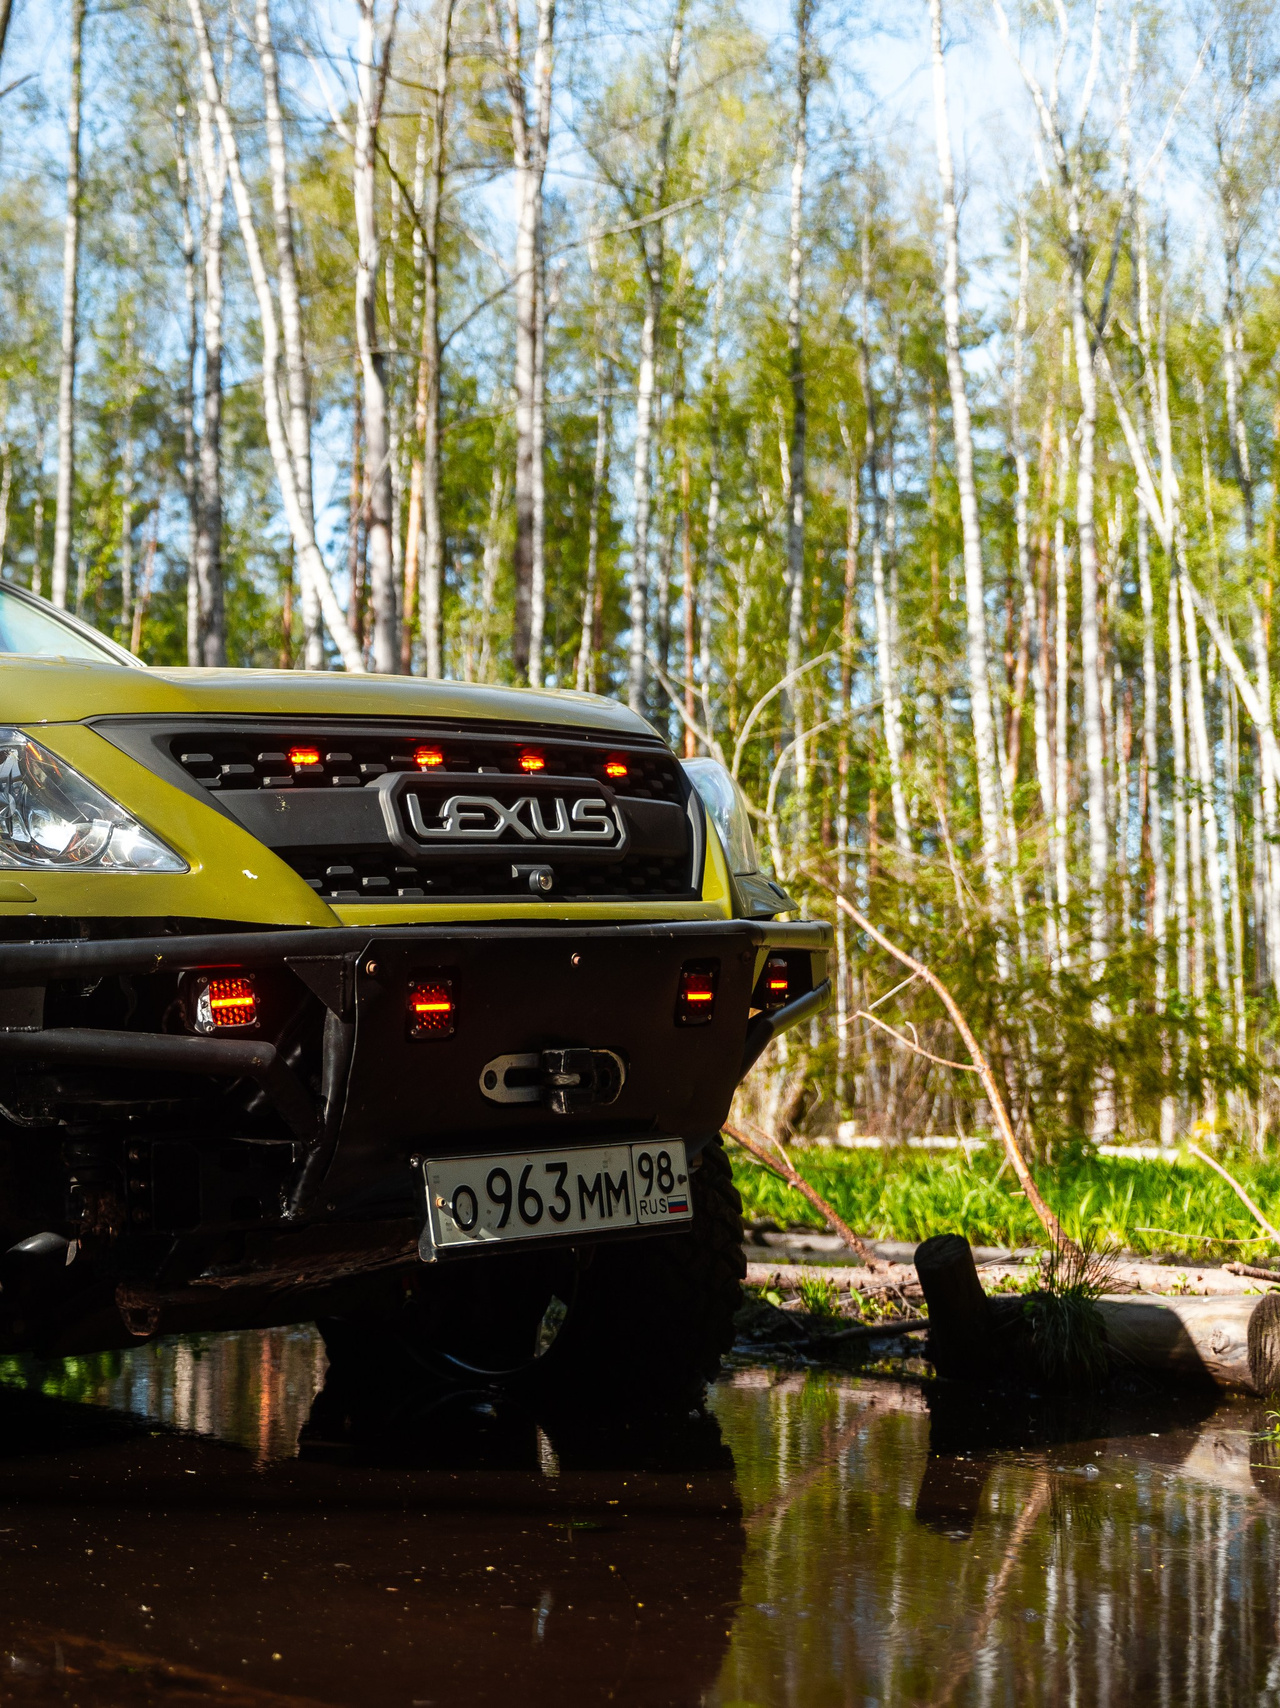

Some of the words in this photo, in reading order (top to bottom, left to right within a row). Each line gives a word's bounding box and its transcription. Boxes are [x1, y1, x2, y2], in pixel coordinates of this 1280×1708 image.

[406, 792, 616, 841] LEXUS
[637, 1150, 675, 1197] 98
[639, 1199, 668, 1216] RUS
